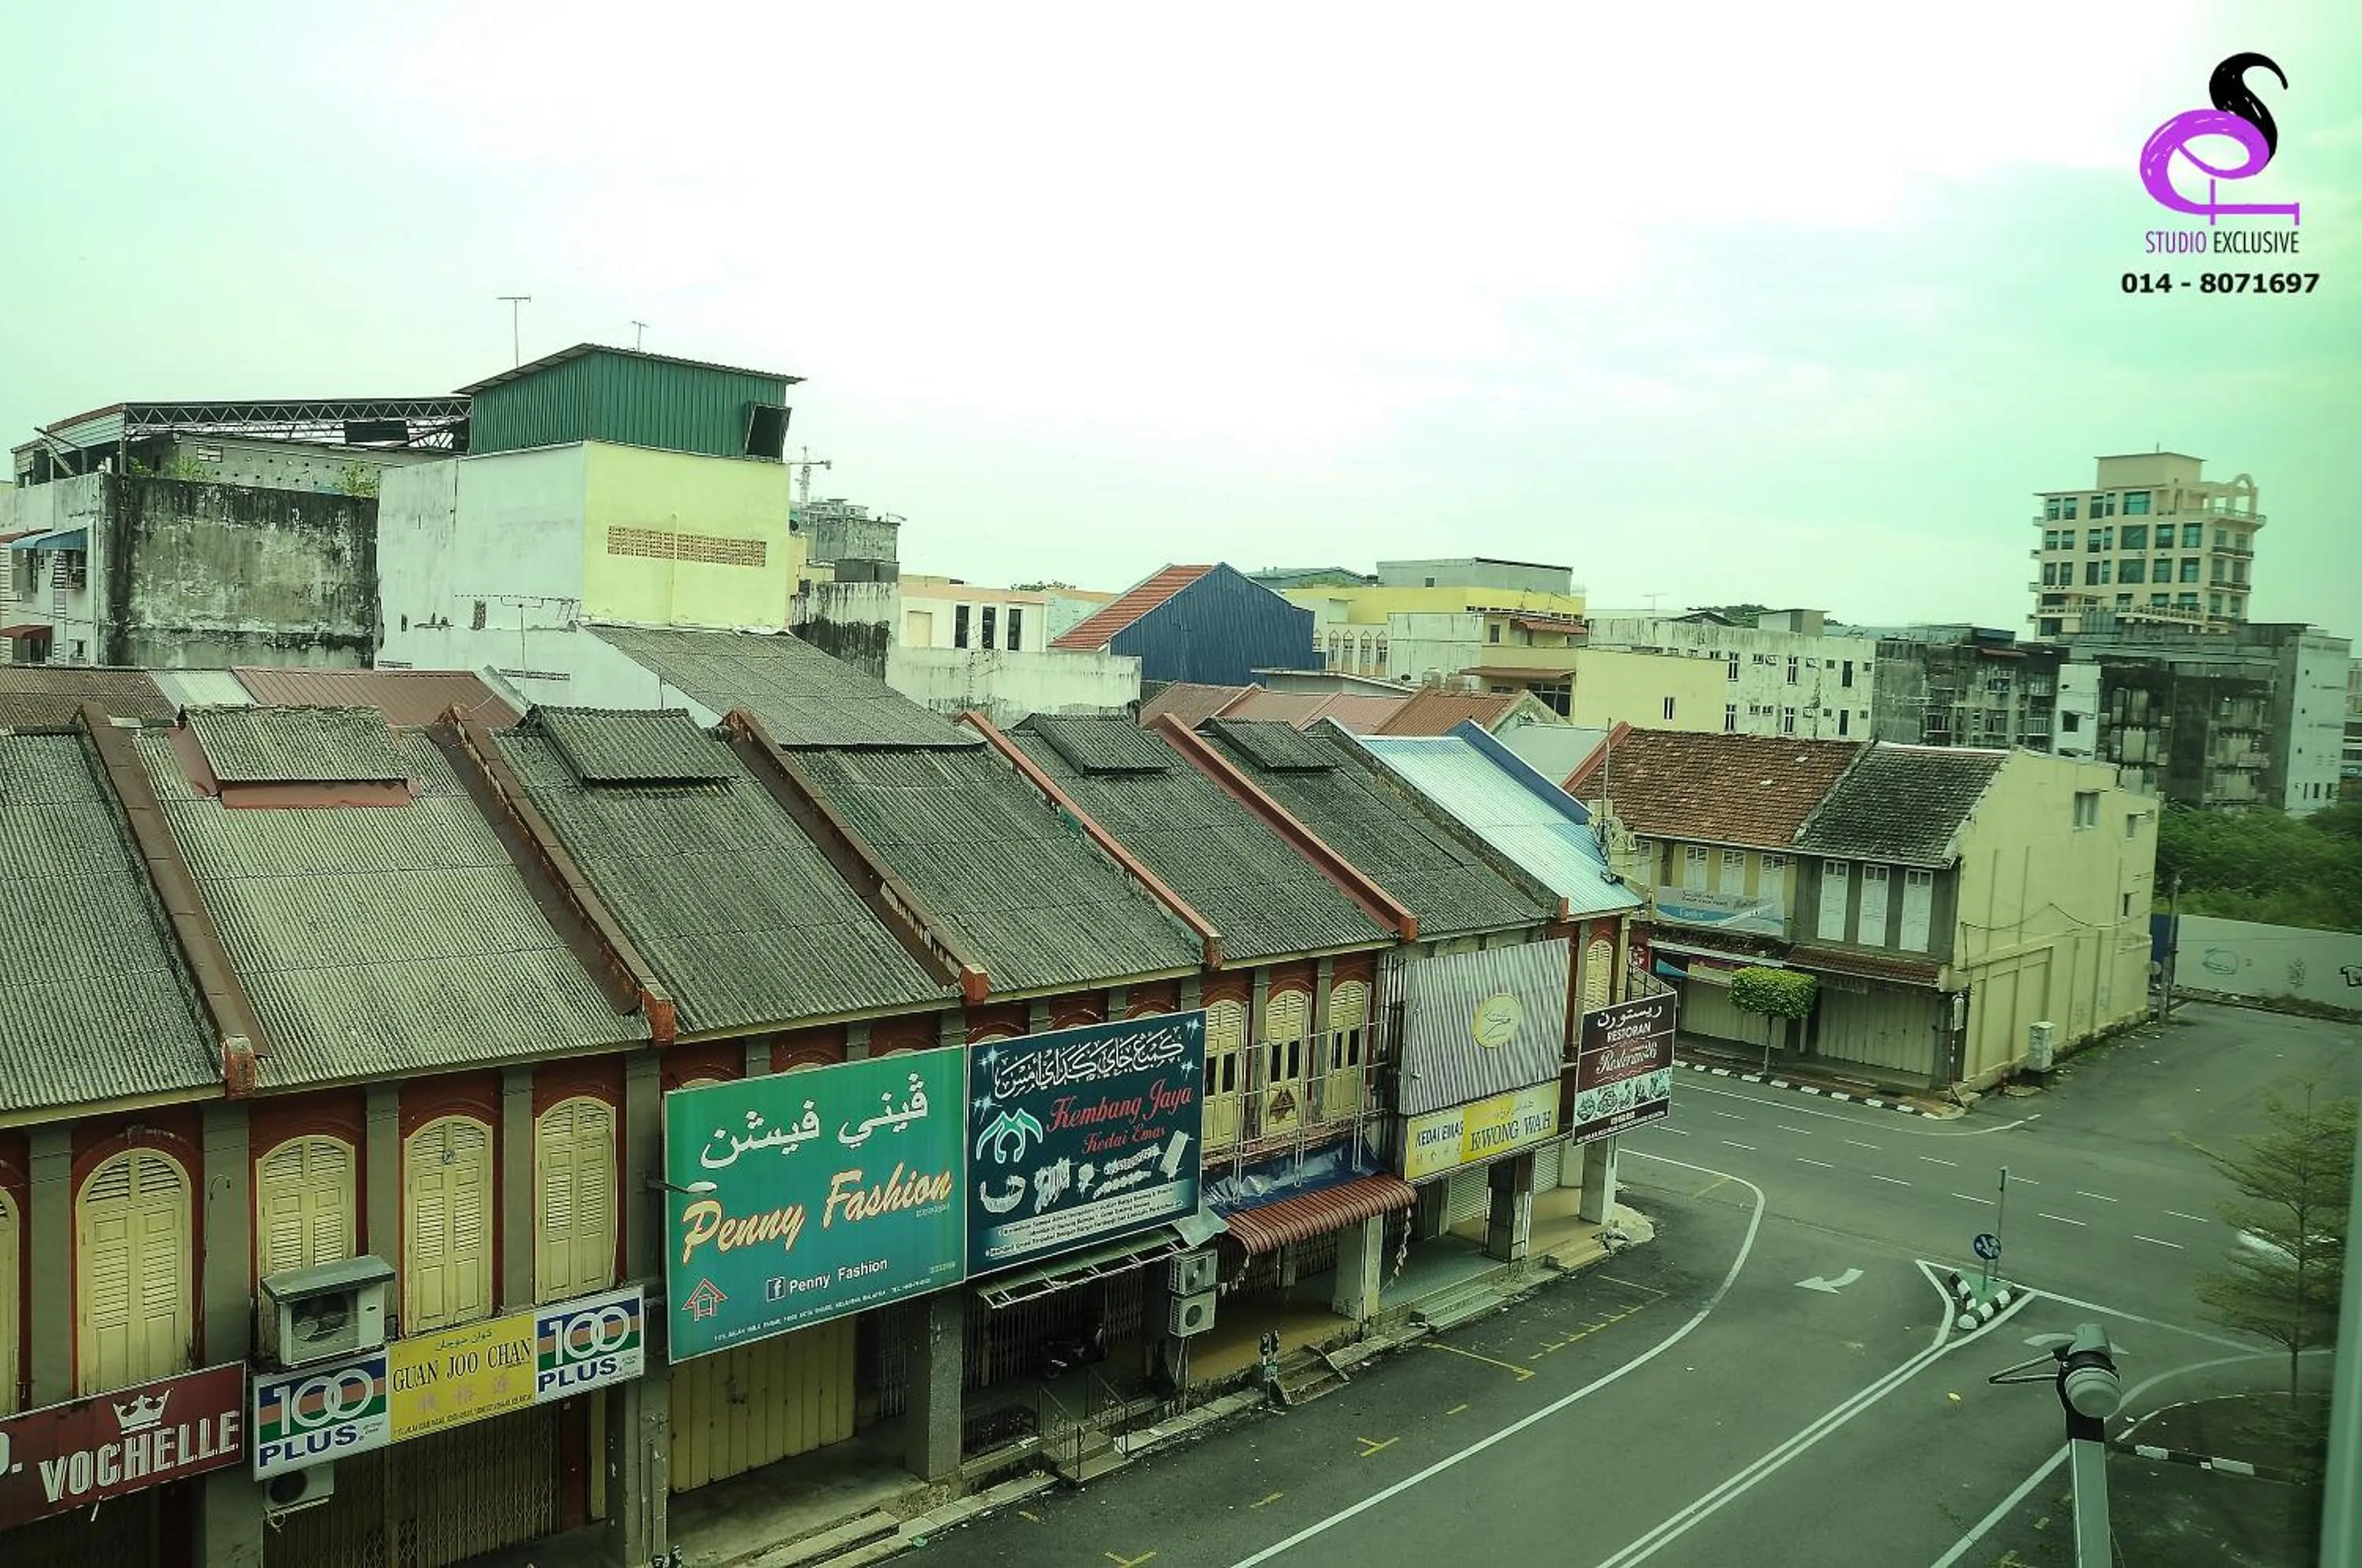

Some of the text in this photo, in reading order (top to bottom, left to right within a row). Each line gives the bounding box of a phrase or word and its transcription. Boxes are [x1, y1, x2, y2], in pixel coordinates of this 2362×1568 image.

[1607, 1020, 1652, 1043] RESTORAN
[1046, 1078, 1194, 1133] Kembang Jaya
[1470, 1119, 1520, 1152] KWONG
[1523, 1109, 1552, 1136] WAH
[681, 1199, 806, 1267] Penny
[822, 1159, 952, 1230] Fashion
[790, 1273, 831, 1295] Penny
[838, 1259, 889, 1282] Fashion
[548, 1305, 631, 1366] 100
[392, 1337, 532, 1392] GUAN JOO CHAN
[537, 1356, 619, 1393] PLUS
[272, 1368, 375, 1437] 100
[38, 1410, 240, 1503] VOCHELLE
[258, 1424, 358, 1469] PLUS
